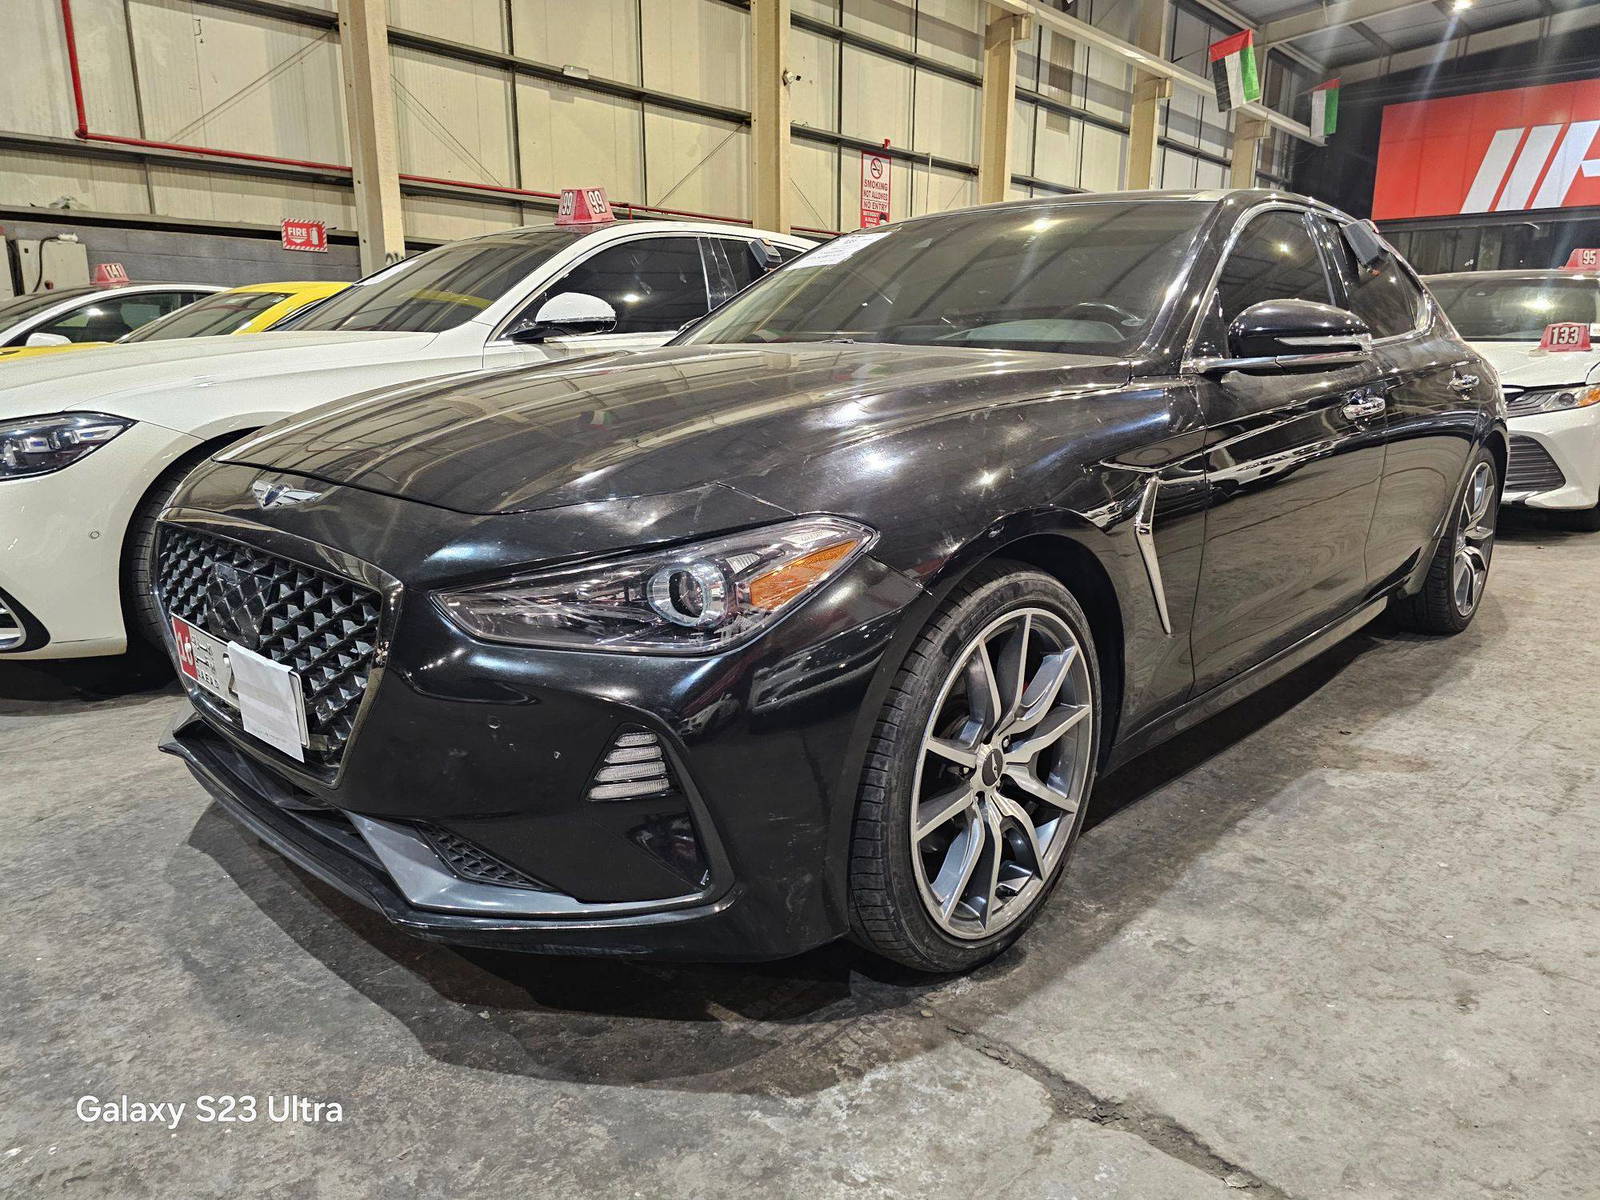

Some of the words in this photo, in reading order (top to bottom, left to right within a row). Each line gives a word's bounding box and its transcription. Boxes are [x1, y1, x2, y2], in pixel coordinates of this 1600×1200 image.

[864, 179, 888, 191] SMOKING
[561, 191, 573, 215] 99
[587, 191, 607, 214] 99
[864, 201, 871, 209] NO
[872, 202, 887, 211] ENTRY
[287, 227, 308, 237] FIRE
[1582, 250, 1596, 265] 95
[104, 264, 123, 278] 141
[1551, 326, 1580, 345] 133
